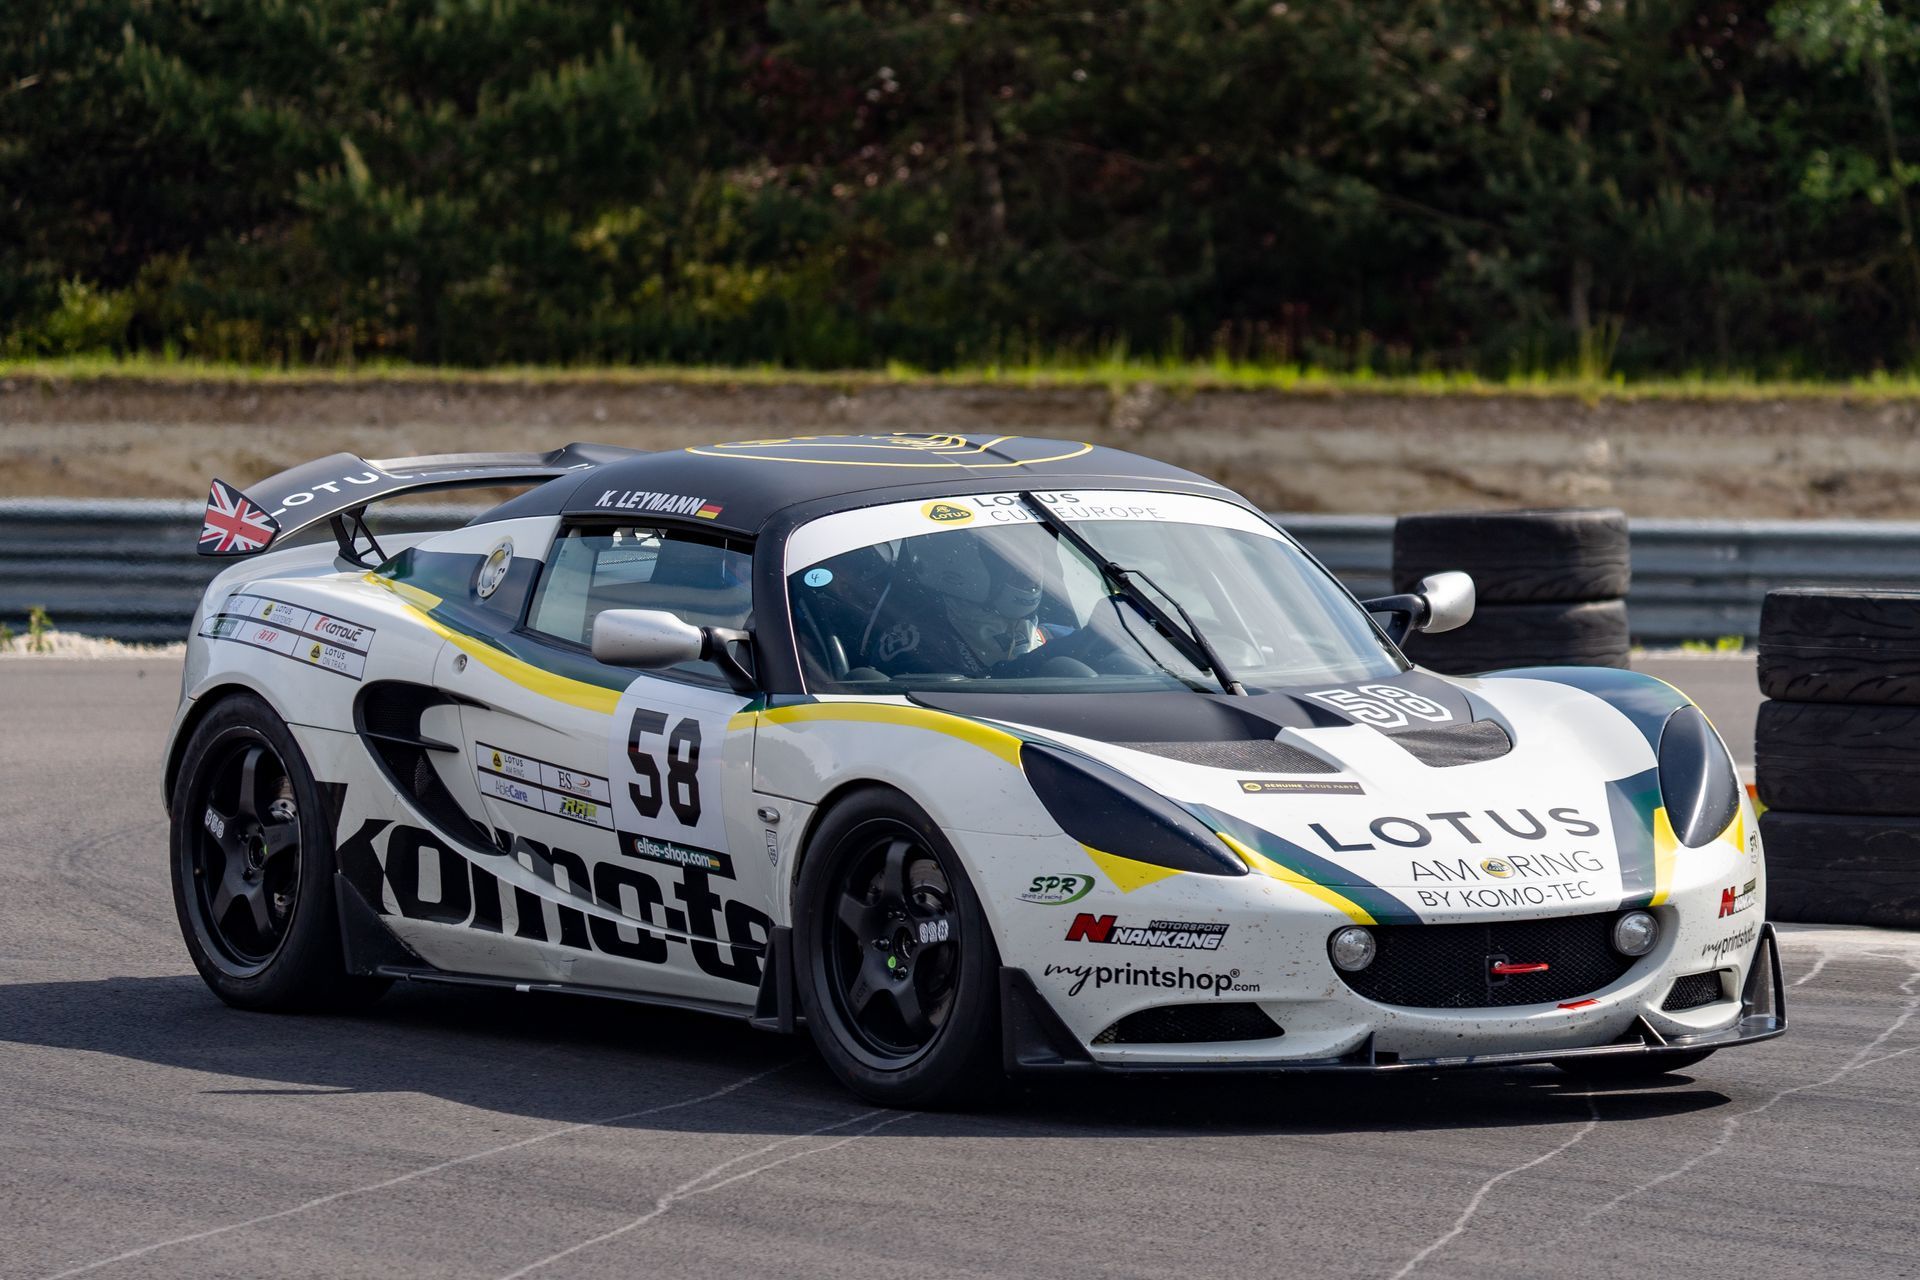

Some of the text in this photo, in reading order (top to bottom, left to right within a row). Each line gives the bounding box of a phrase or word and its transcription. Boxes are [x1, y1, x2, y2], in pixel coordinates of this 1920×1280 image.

[595, 490, 707, 515] K. LEYMANN
[972, 493, 1080, 508] LOUS
[932, 510, 969, 520] LOTUS
[1057, 504, 1166, 519] EUROPE
[275, 605, 294, 615] LOTUS
[325, 647, 346, 660] LOTUS
[1304, 684, 1454, 729] 58
[504, 755, 524, 768] LOTUS
[628, 707, 702, 828] 58
[557, 771, 573, 790] ES
[1308, 807, 1601, 852] LOTUS
[636, 837, 712, 869] elise-shop.com
[1029, 876, 1077, 894] SPR
[1417, 881, 1597, 908] BY KOMO-TEC
[1150, 921, 1228, 932] MOTORSPORT
[1110, 925, 1223, 949] NANKANG
